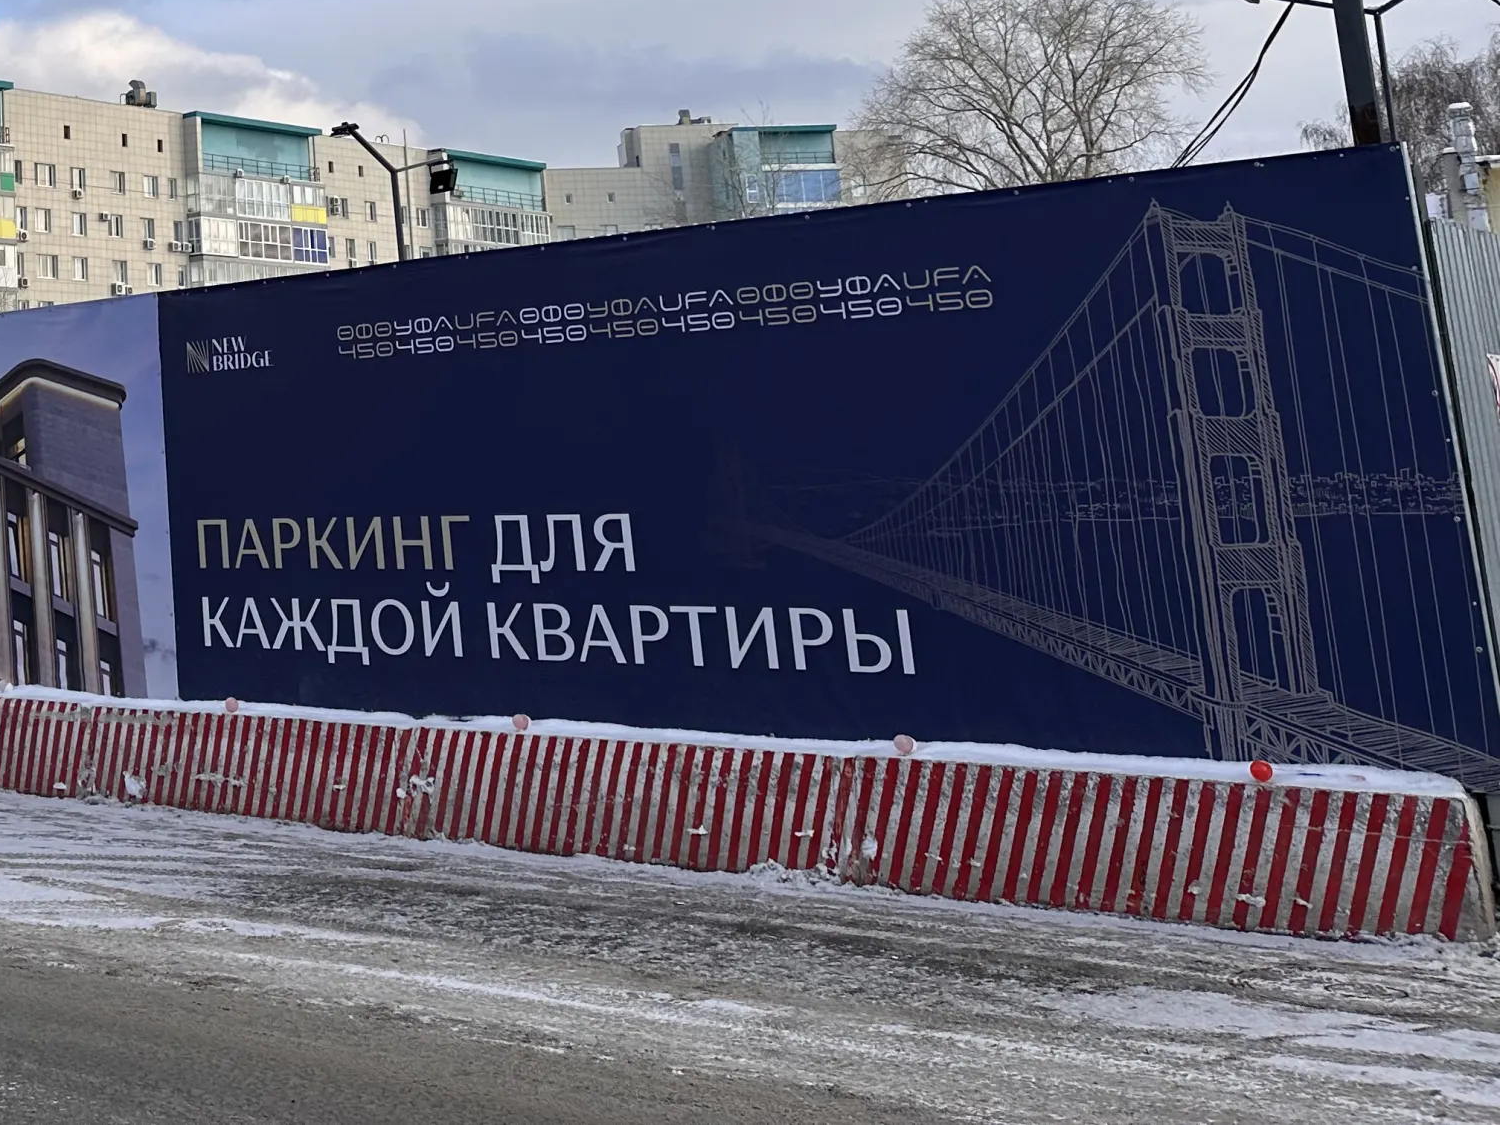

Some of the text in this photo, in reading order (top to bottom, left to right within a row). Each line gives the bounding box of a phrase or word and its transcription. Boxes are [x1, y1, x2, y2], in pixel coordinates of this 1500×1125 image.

[212, 336, 247, 354] NEW
[213, 350, 274, 371] BRIDGE
[197, 513, 637, 584] ПАРКИНГ ДЛЯ
[201, 581, 916, 675] КАЖДОЙ КВАРТИРЫ
